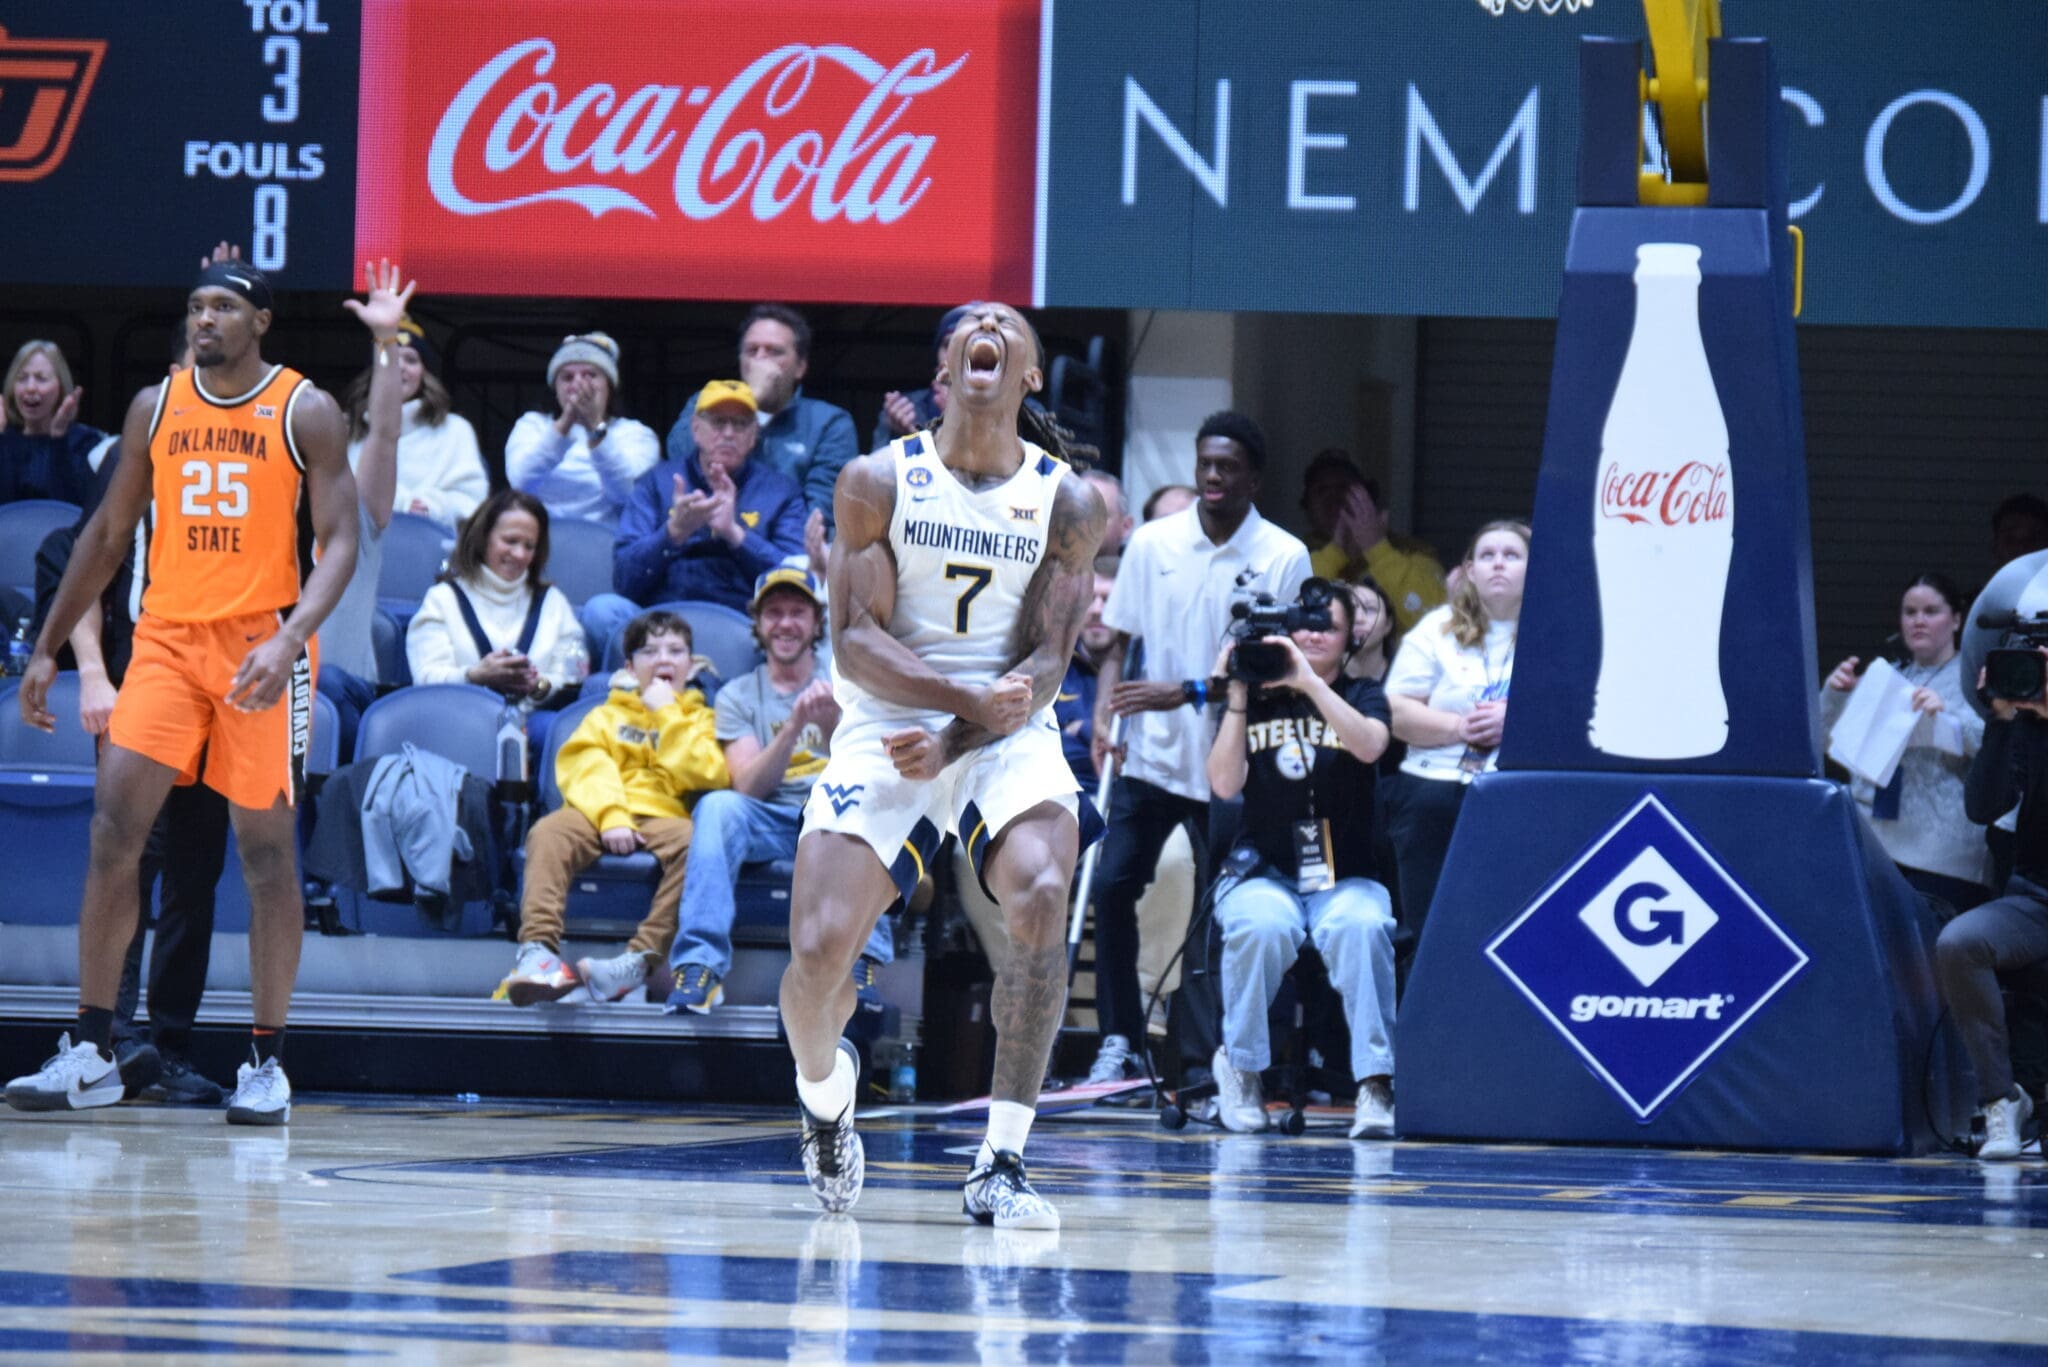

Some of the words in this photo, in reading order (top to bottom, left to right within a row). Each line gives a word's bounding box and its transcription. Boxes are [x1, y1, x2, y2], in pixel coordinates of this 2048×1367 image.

[243, 0, 329, 33] TOL
[262, 35, 300, 123] 3
[184, 140, 325, 179] FOULS
[427, 37, 971, 225] Coca-Cola
[253, 184, 288, 271] 8
[168, 427, 267, 461] OKLAHOMA
[181, 460, 249, 518] 25
[1601, 460, 1727, 526] Coca-Cola
[187, 525, 241, 553] STATE
[904, 519, 1040, 565] MOUNTAINEERS
[945, 562, 994, 635] 7
[292, 657, 310, 756] COWBOYS
[1247, 716, 1343, 753] STEELER
[1613, 881, 1685, 947] G
[1569, 993, 1725, 1022] gomart
